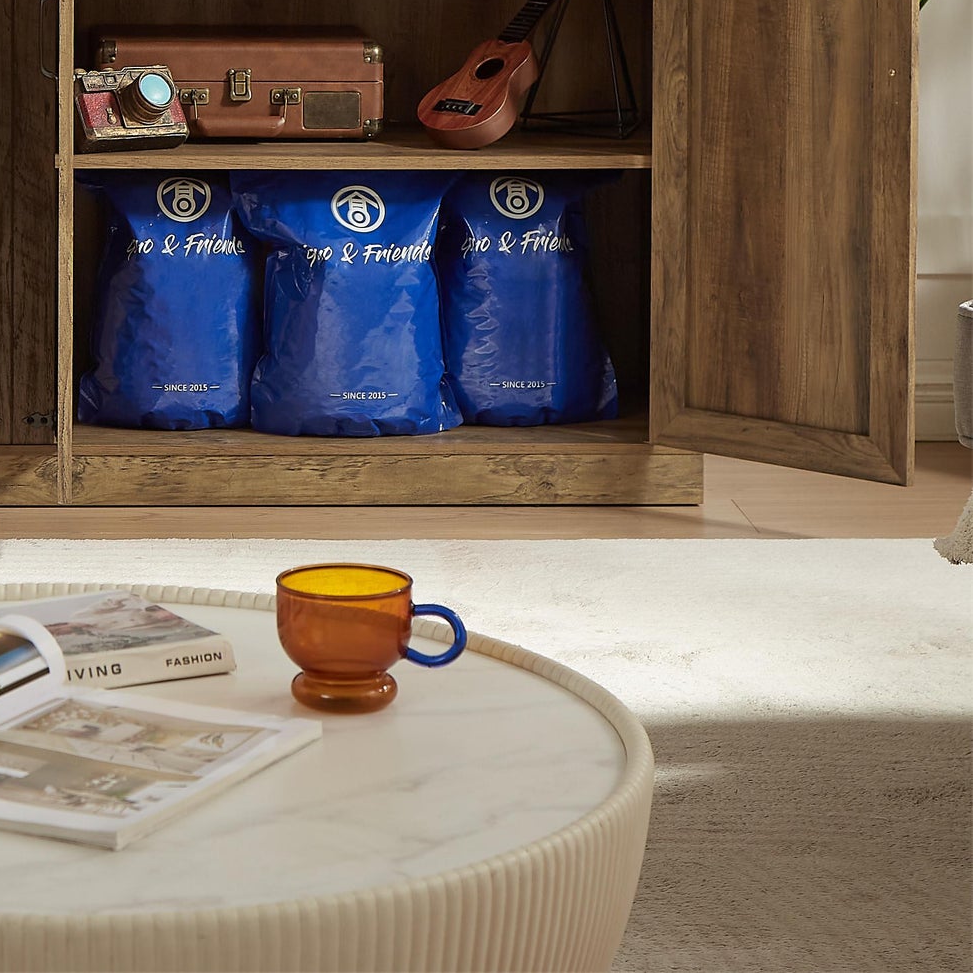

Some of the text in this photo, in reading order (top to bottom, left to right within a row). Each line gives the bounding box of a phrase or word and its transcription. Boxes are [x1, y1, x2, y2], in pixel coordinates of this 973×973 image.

[161, 234, 180, 256] &
[183, 233, 246, 257] Friends
[340, 242, 359, 264] &
[362, 240, 432, 265] Friends
[498, 231, 517, 253] &
[163, 383, 208, 392] SINCE 2015
[342, 391, 387, 400] SINCE 2015
[502, 380, 546, 389] SINCE 2015
[66, 651, 223, 682] IVING FASHION
